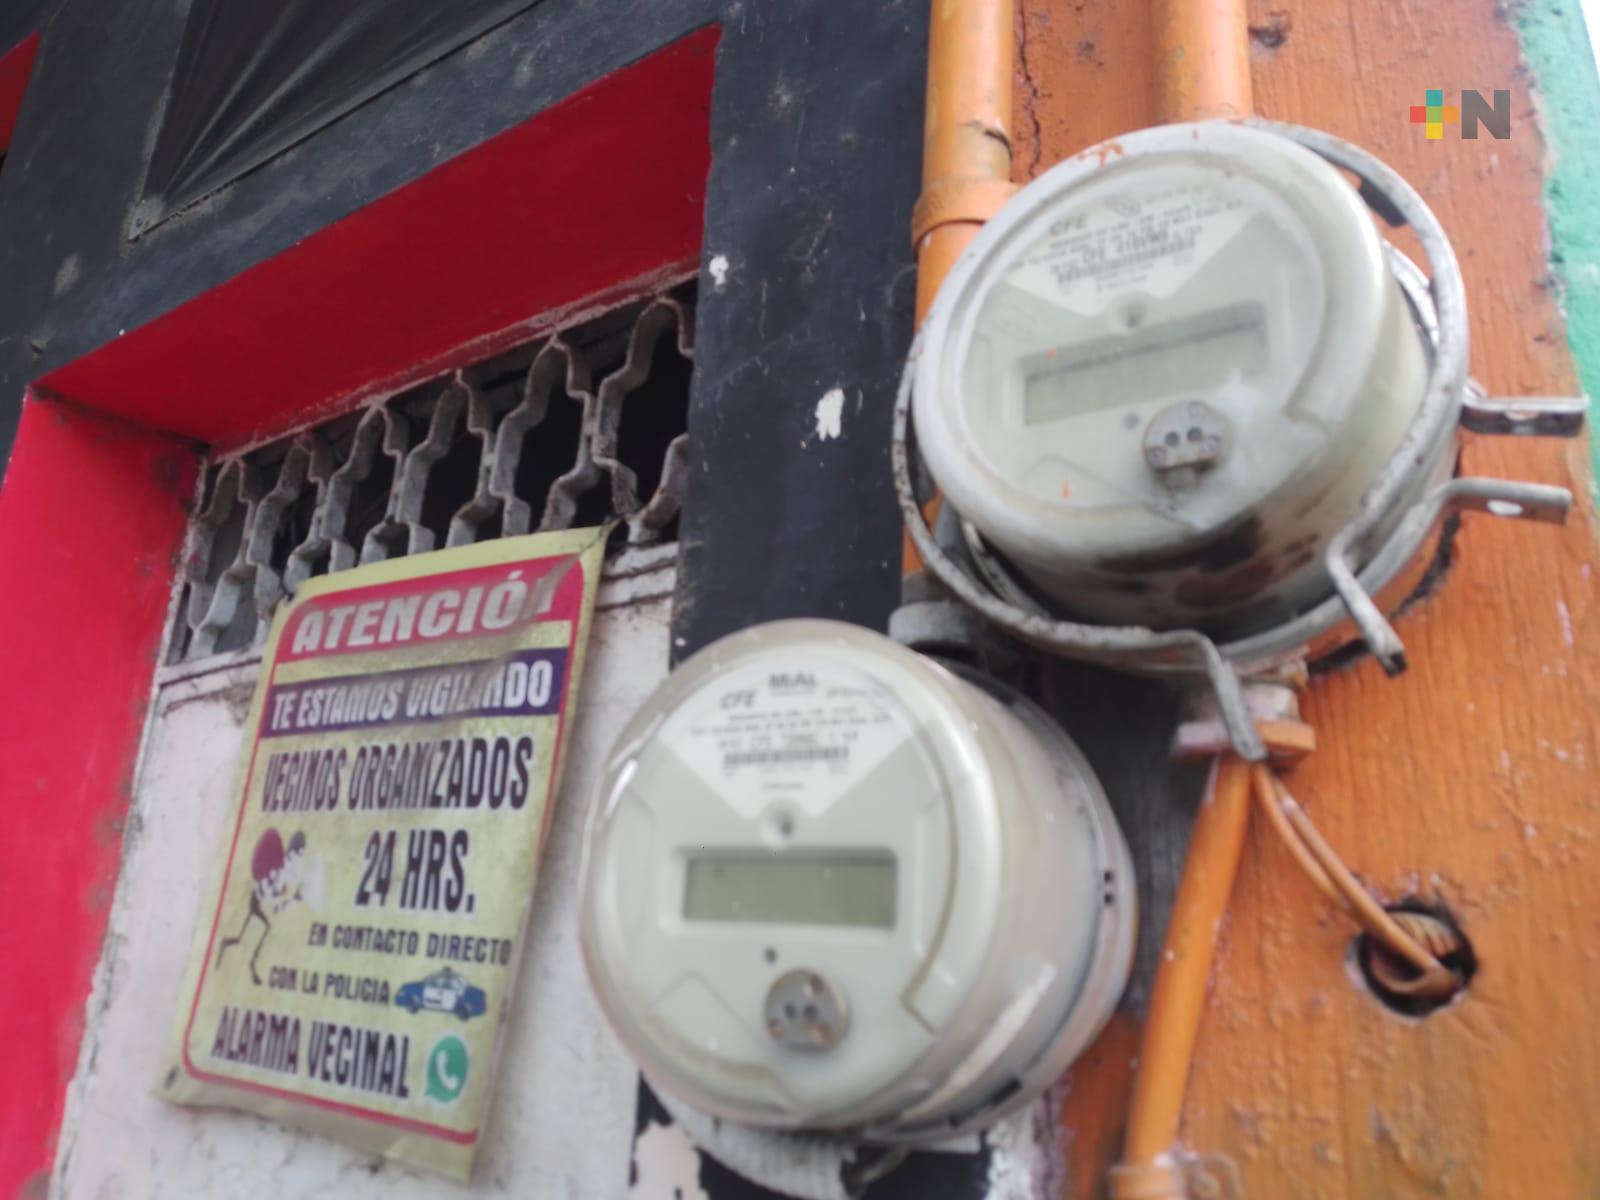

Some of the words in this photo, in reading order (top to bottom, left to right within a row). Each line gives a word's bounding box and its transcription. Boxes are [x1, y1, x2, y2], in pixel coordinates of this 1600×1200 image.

[272, 690, 298, 731] TE
[297, 683, 404, 729] ESTAMOS
[262, 746, 347, 812] VECINOS
[348, 736, 534, 811] ORGANIZADOS
[355, 830, 397, 907] 24
[399, 829, 476, 914] HRS.
[308, 923, 327, 946] EN
[332, 925, 419, 956] CONTACTO
[425, 933, 512, 966] DIRECTO
[268, 966, 300, 991] CON
[301, 972, 318, 994] LA
[323, 975, 390, 1007] POLICIA
[212, 1006, 300, 1074] ALARMA
[307, 1020, 411, 1099] VECINAL
